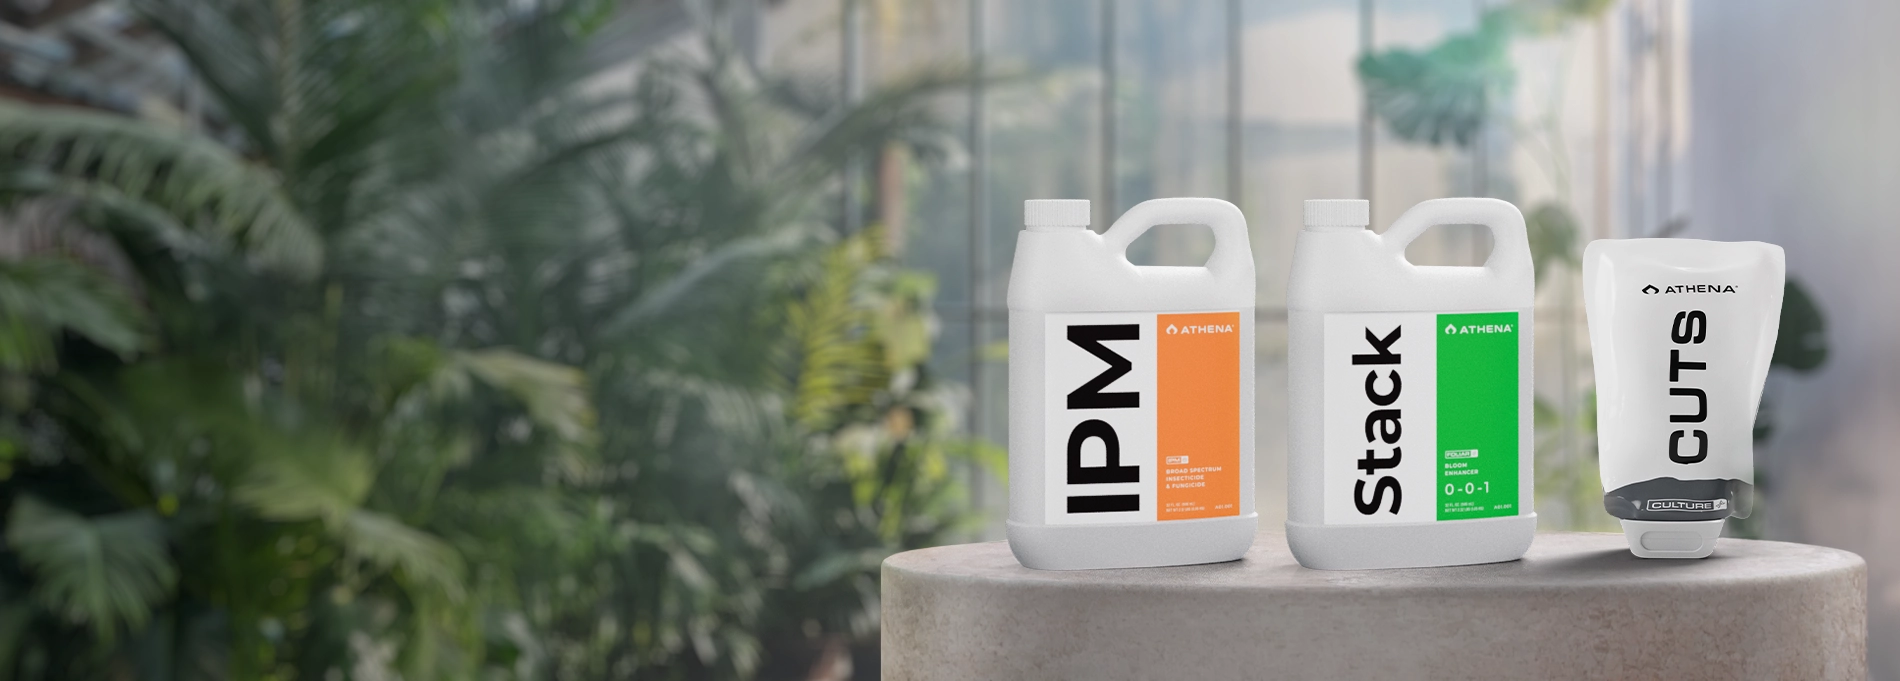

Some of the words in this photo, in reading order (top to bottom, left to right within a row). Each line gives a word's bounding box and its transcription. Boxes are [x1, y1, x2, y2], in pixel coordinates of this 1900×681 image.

[1665, 284, 1735, 294] ATHENA
[1180, 324, 1233, 335] ATHENA
[1459, 324, 1512, 335] ATHENA
[1669, 310, 1708, 465] CUTS
[1067, 324, 1140, 514] IPM
[1352, 325, 1402, 516] Stack
[1166, 474, 1205, 482] INSECTICIDE
[1172, 481, 1206, 489] FUNGICIDE
[1651, 501, 1712, 510] CULTURE
